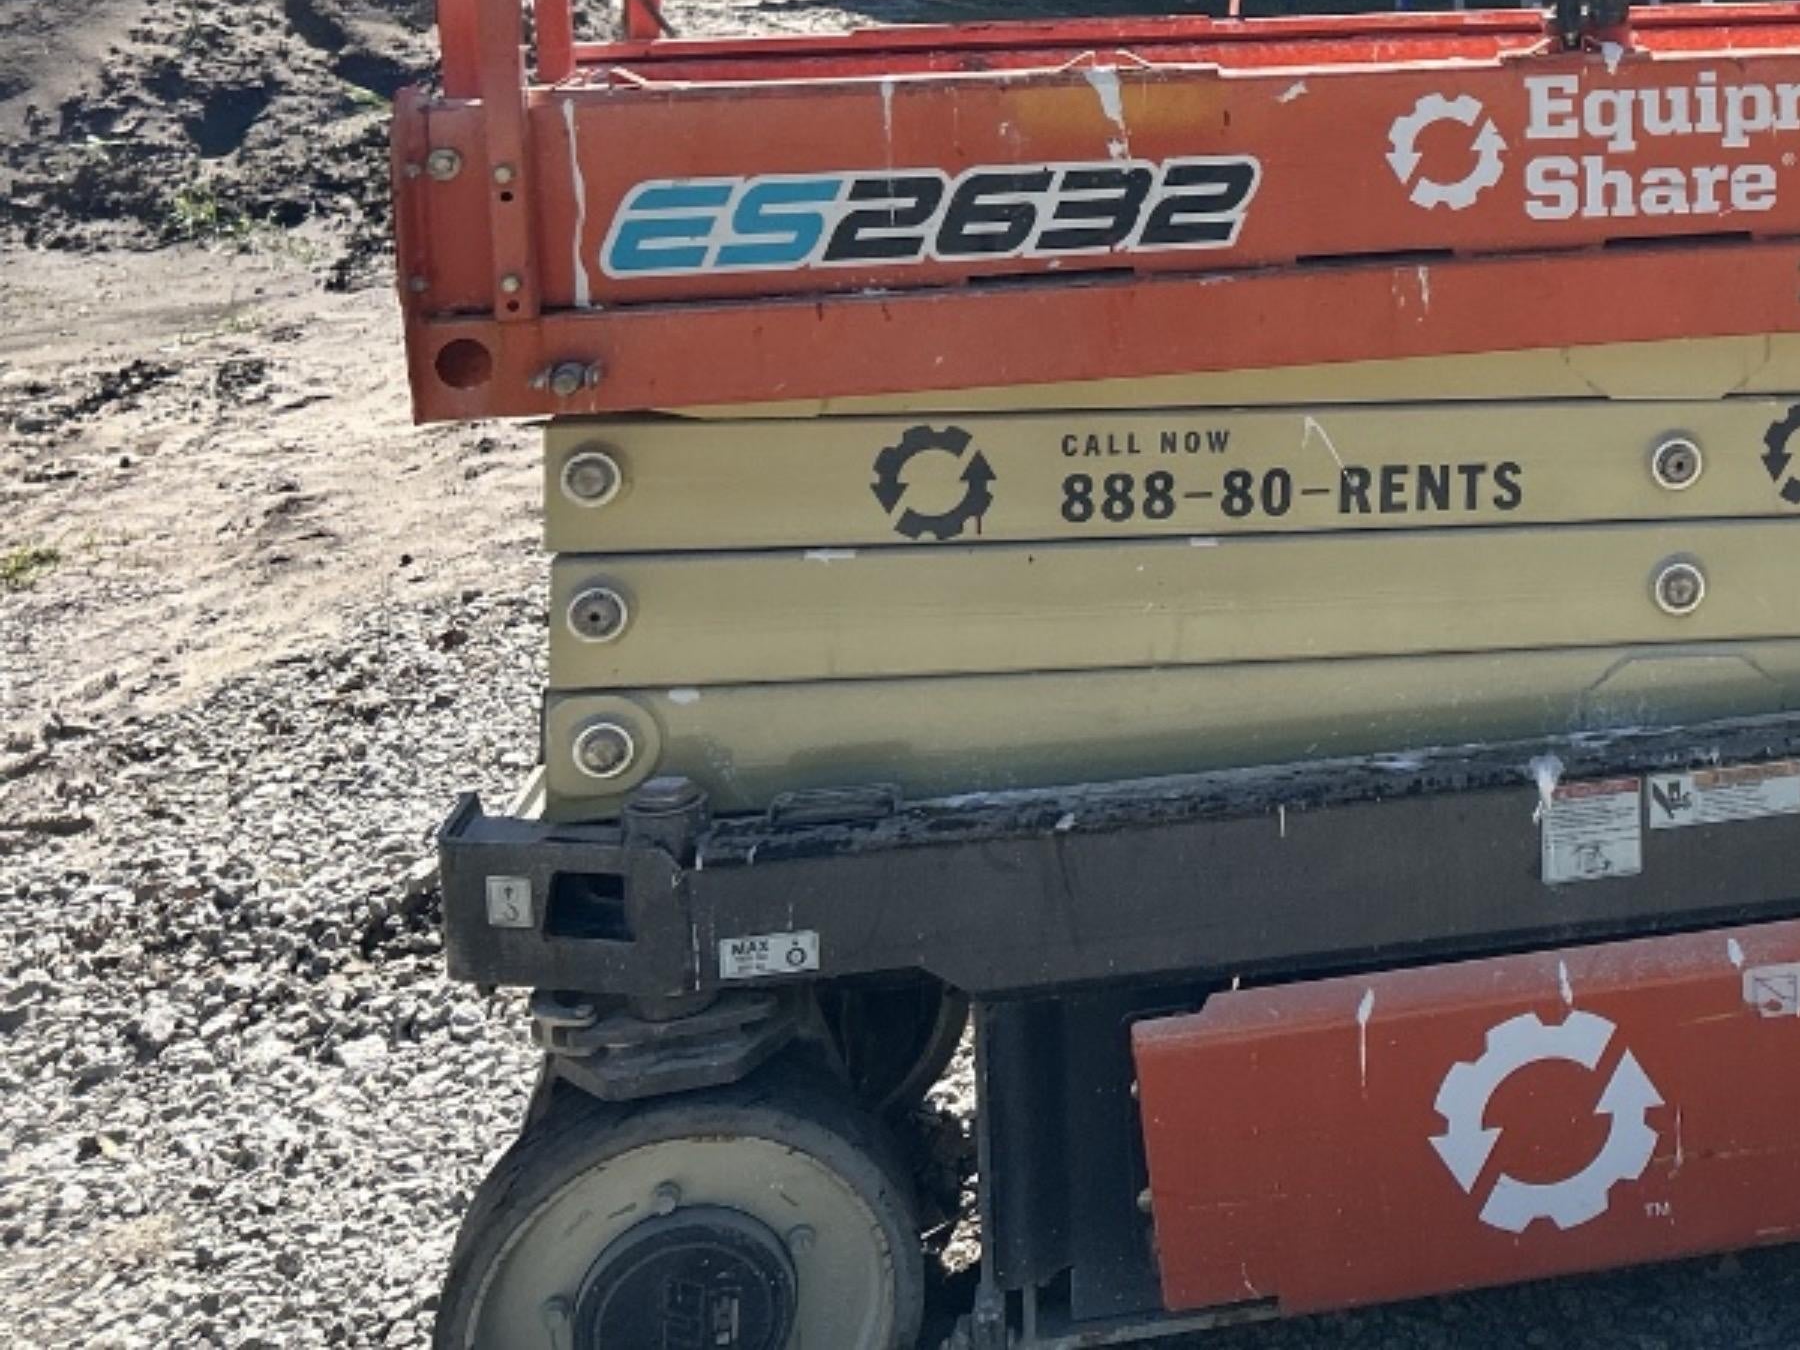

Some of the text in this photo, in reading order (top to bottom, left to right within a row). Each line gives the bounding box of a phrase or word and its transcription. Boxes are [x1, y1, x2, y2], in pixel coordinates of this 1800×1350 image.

[600, 154, 1262, 280] ES2632
[1060, 429, 1232, 458] CALL NOW
[1060, 461, 1524, 523] 888-80-RENTS
